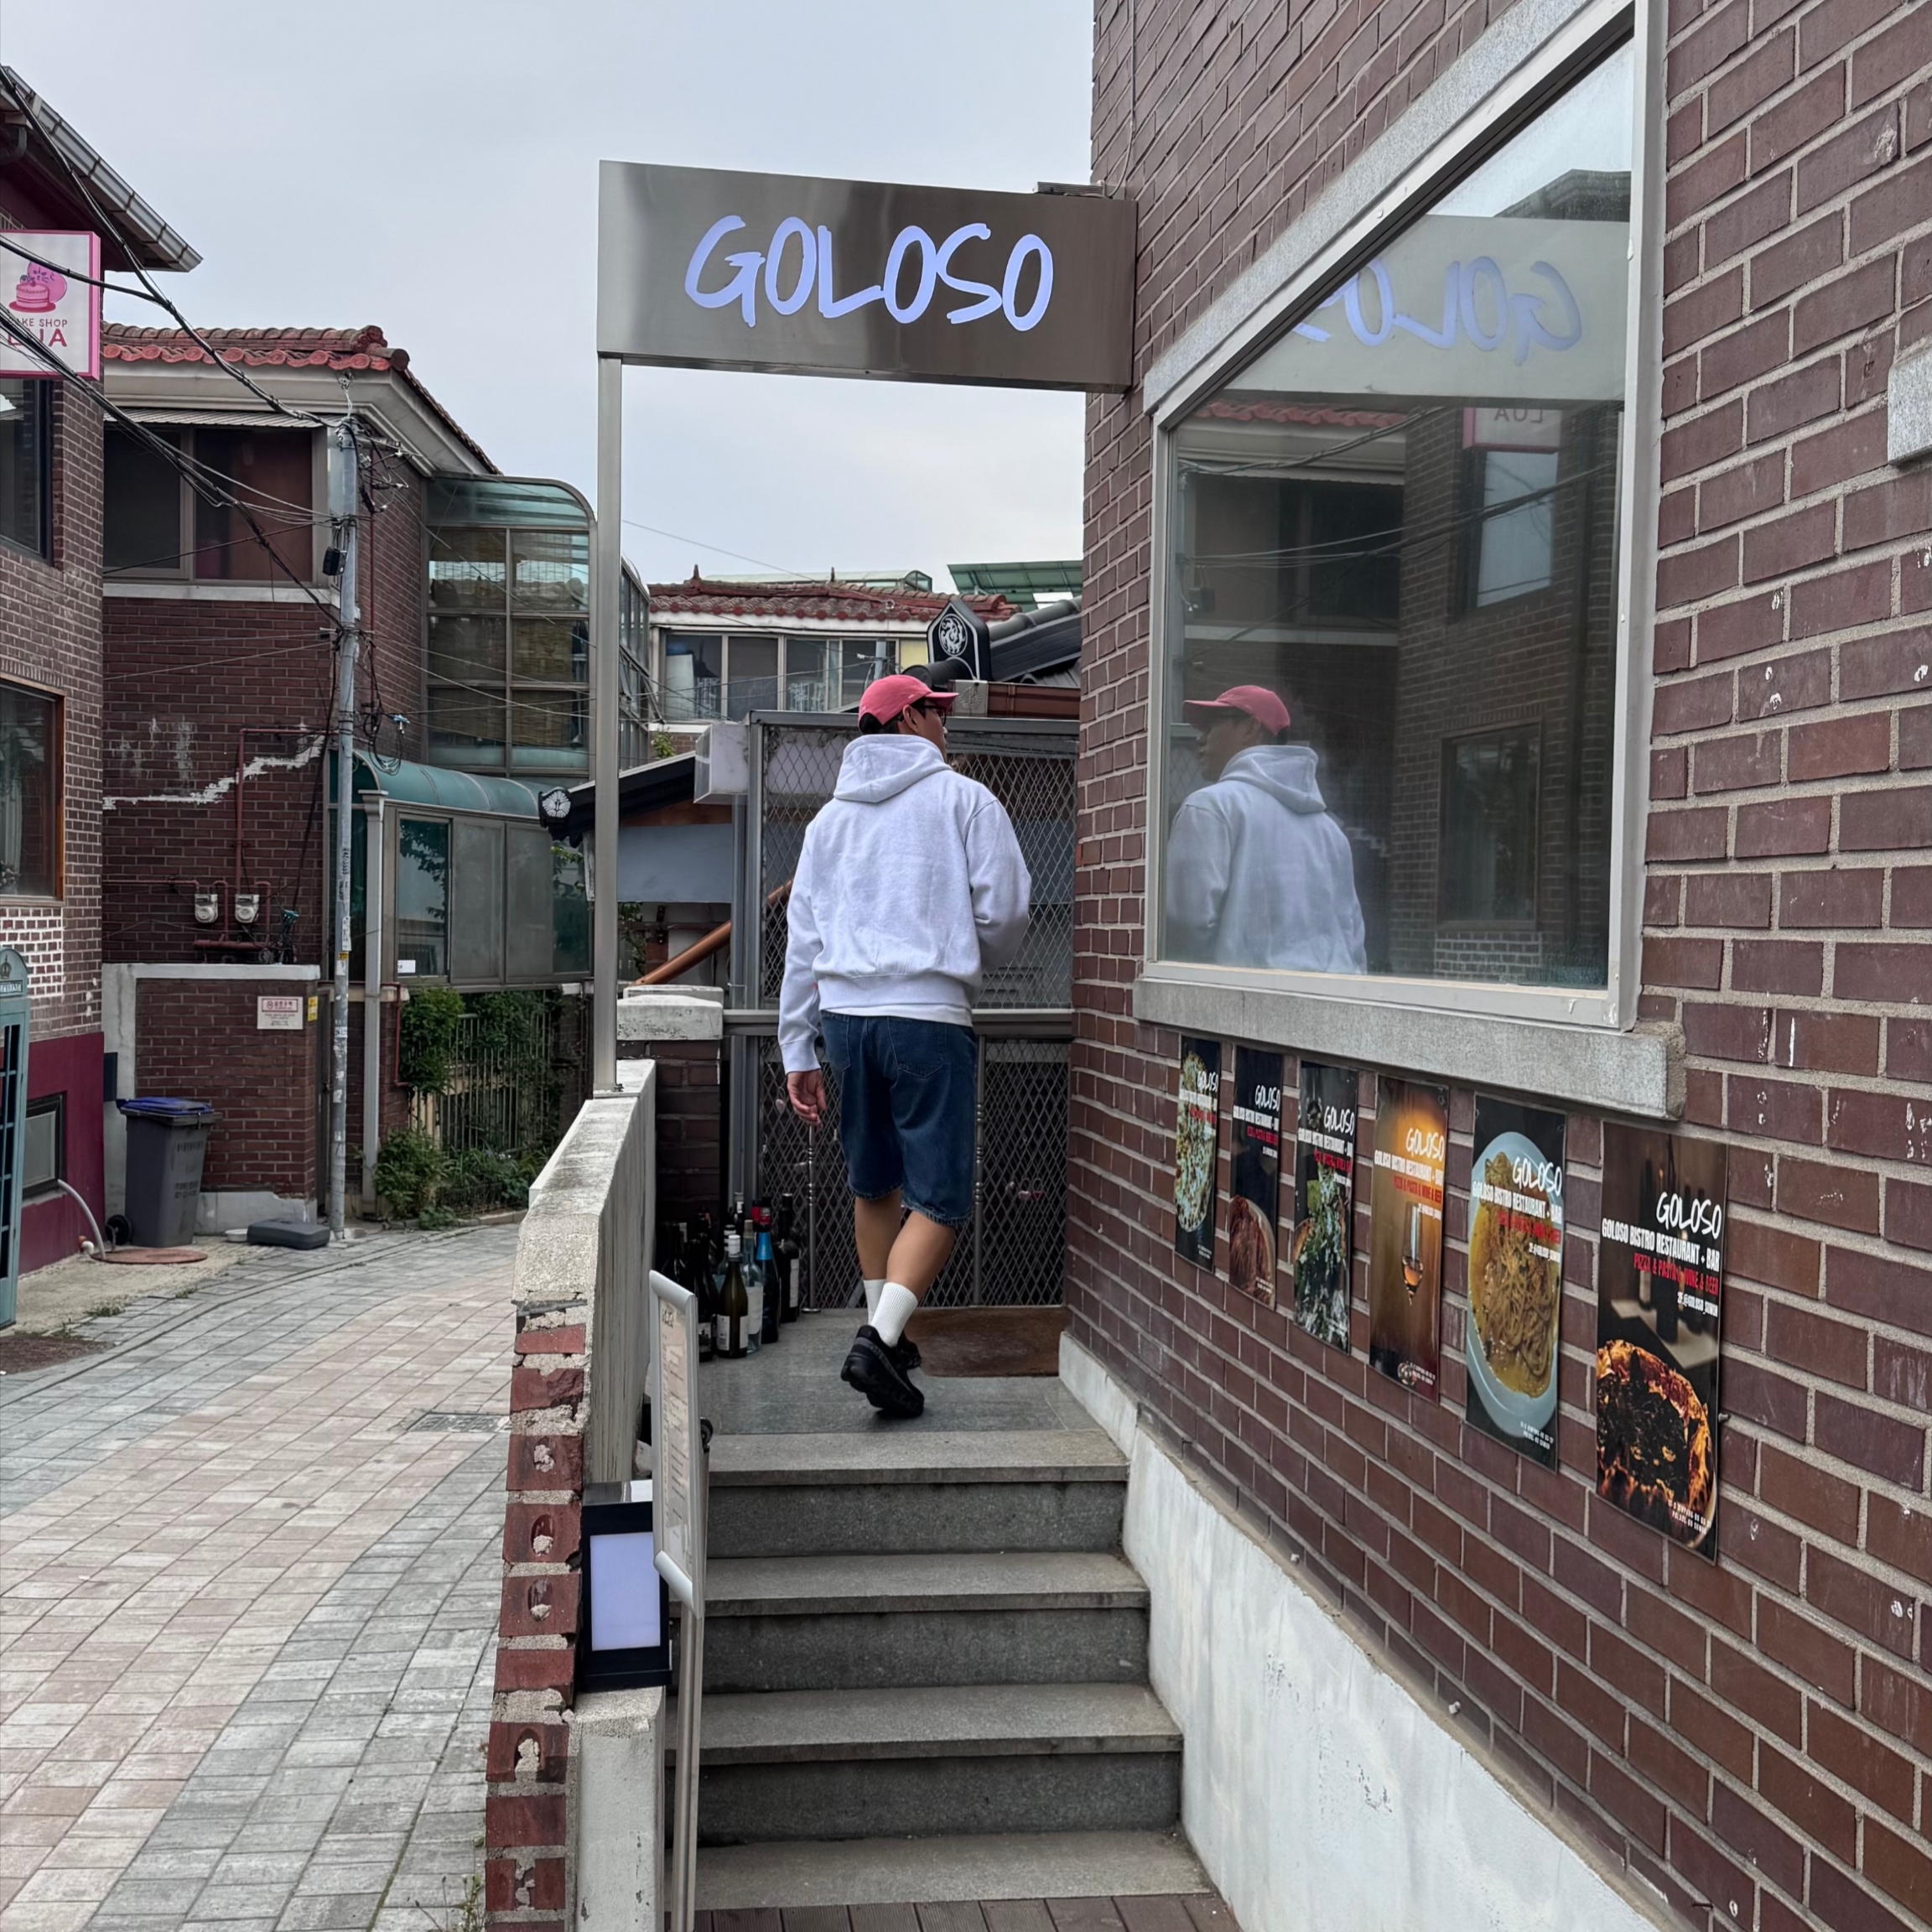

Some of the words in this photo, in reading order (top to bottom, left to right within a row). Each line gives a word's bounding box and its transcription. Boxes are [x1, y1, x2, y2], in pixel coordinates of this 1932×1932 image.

[684, 215, 1053, 331] GOLOSO
[39, 319, 68, 327] SHOP
[1324, 1106, 1355, 1136] GOLOSO
[1406, 1127, 1444, 1162] GOLOSO
[1513, 1156, 1562, 1197] GOLOSO
[1656, 1192, 1722, 1239] GOLOSO
[1602, 1218, 1628, 1244] GOLOSO
[1629, 1225, 1655, 1251] BISTRO
[1656, 1233, 1701, 1265] RESTAURANT
[1706, 1247, 1720, 1272] BAR
[1633, 1253, 1651, 1272] PIZZA
